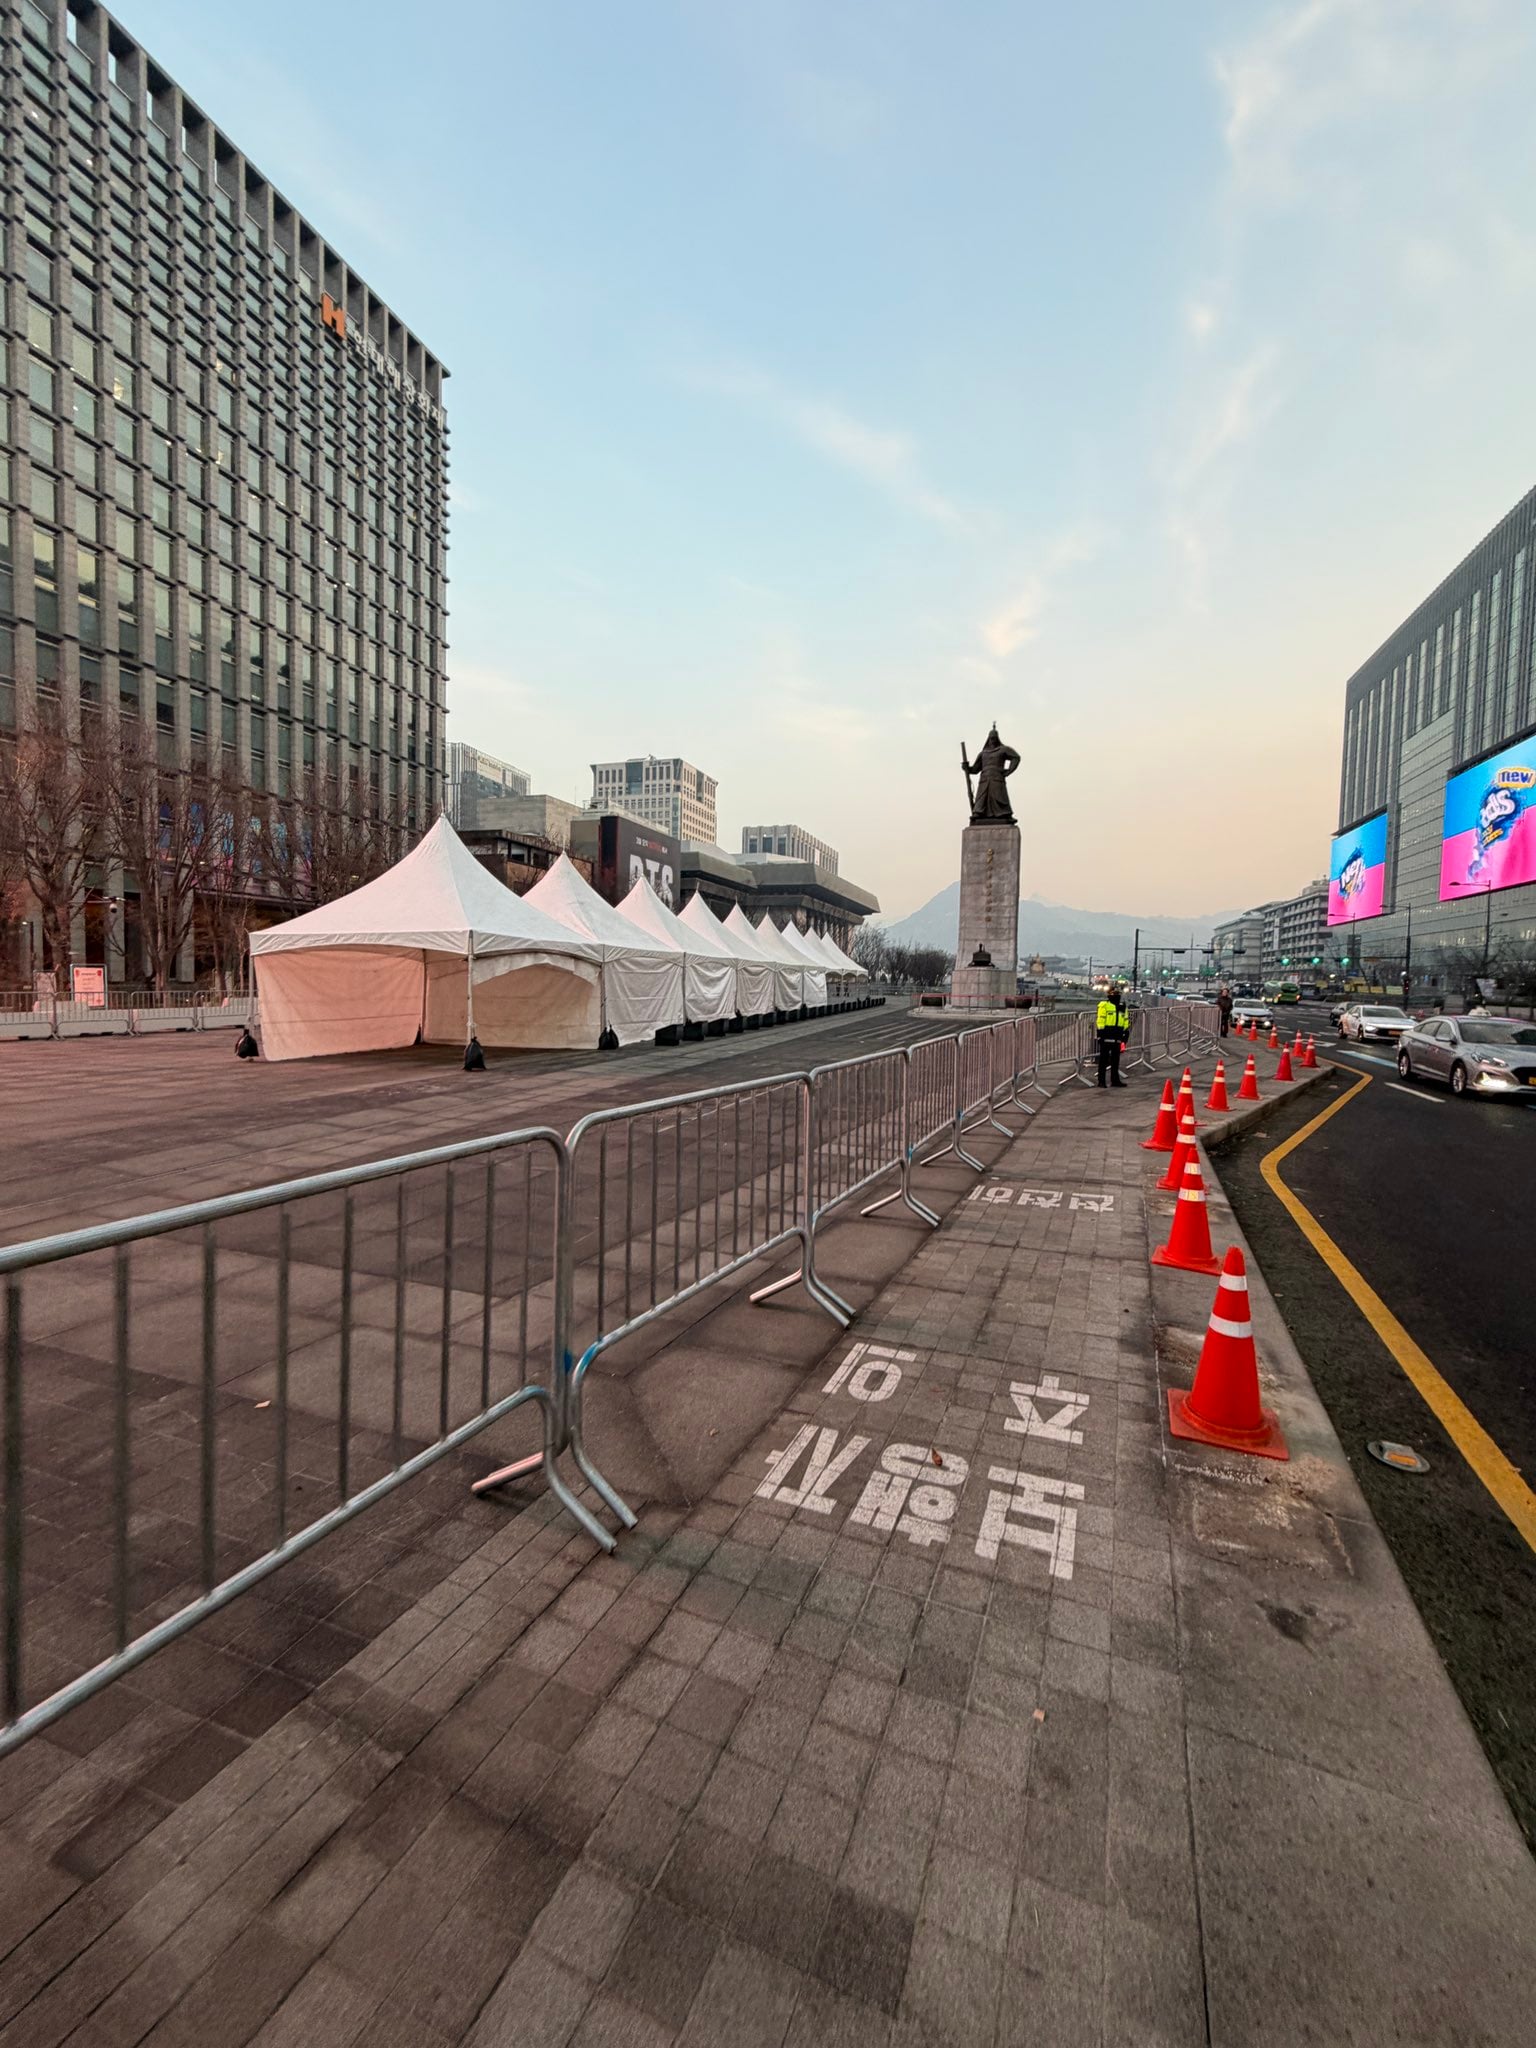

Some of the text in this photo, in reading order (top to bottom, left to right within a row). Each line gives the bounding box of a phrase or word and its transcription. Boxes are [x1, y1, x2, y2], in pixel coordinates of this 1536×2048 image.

[1499, 771, 1533, 783] new
[968, 1185, 1115, 1213] 천천히
[754, 1424, 1086, 1580] 보행자
